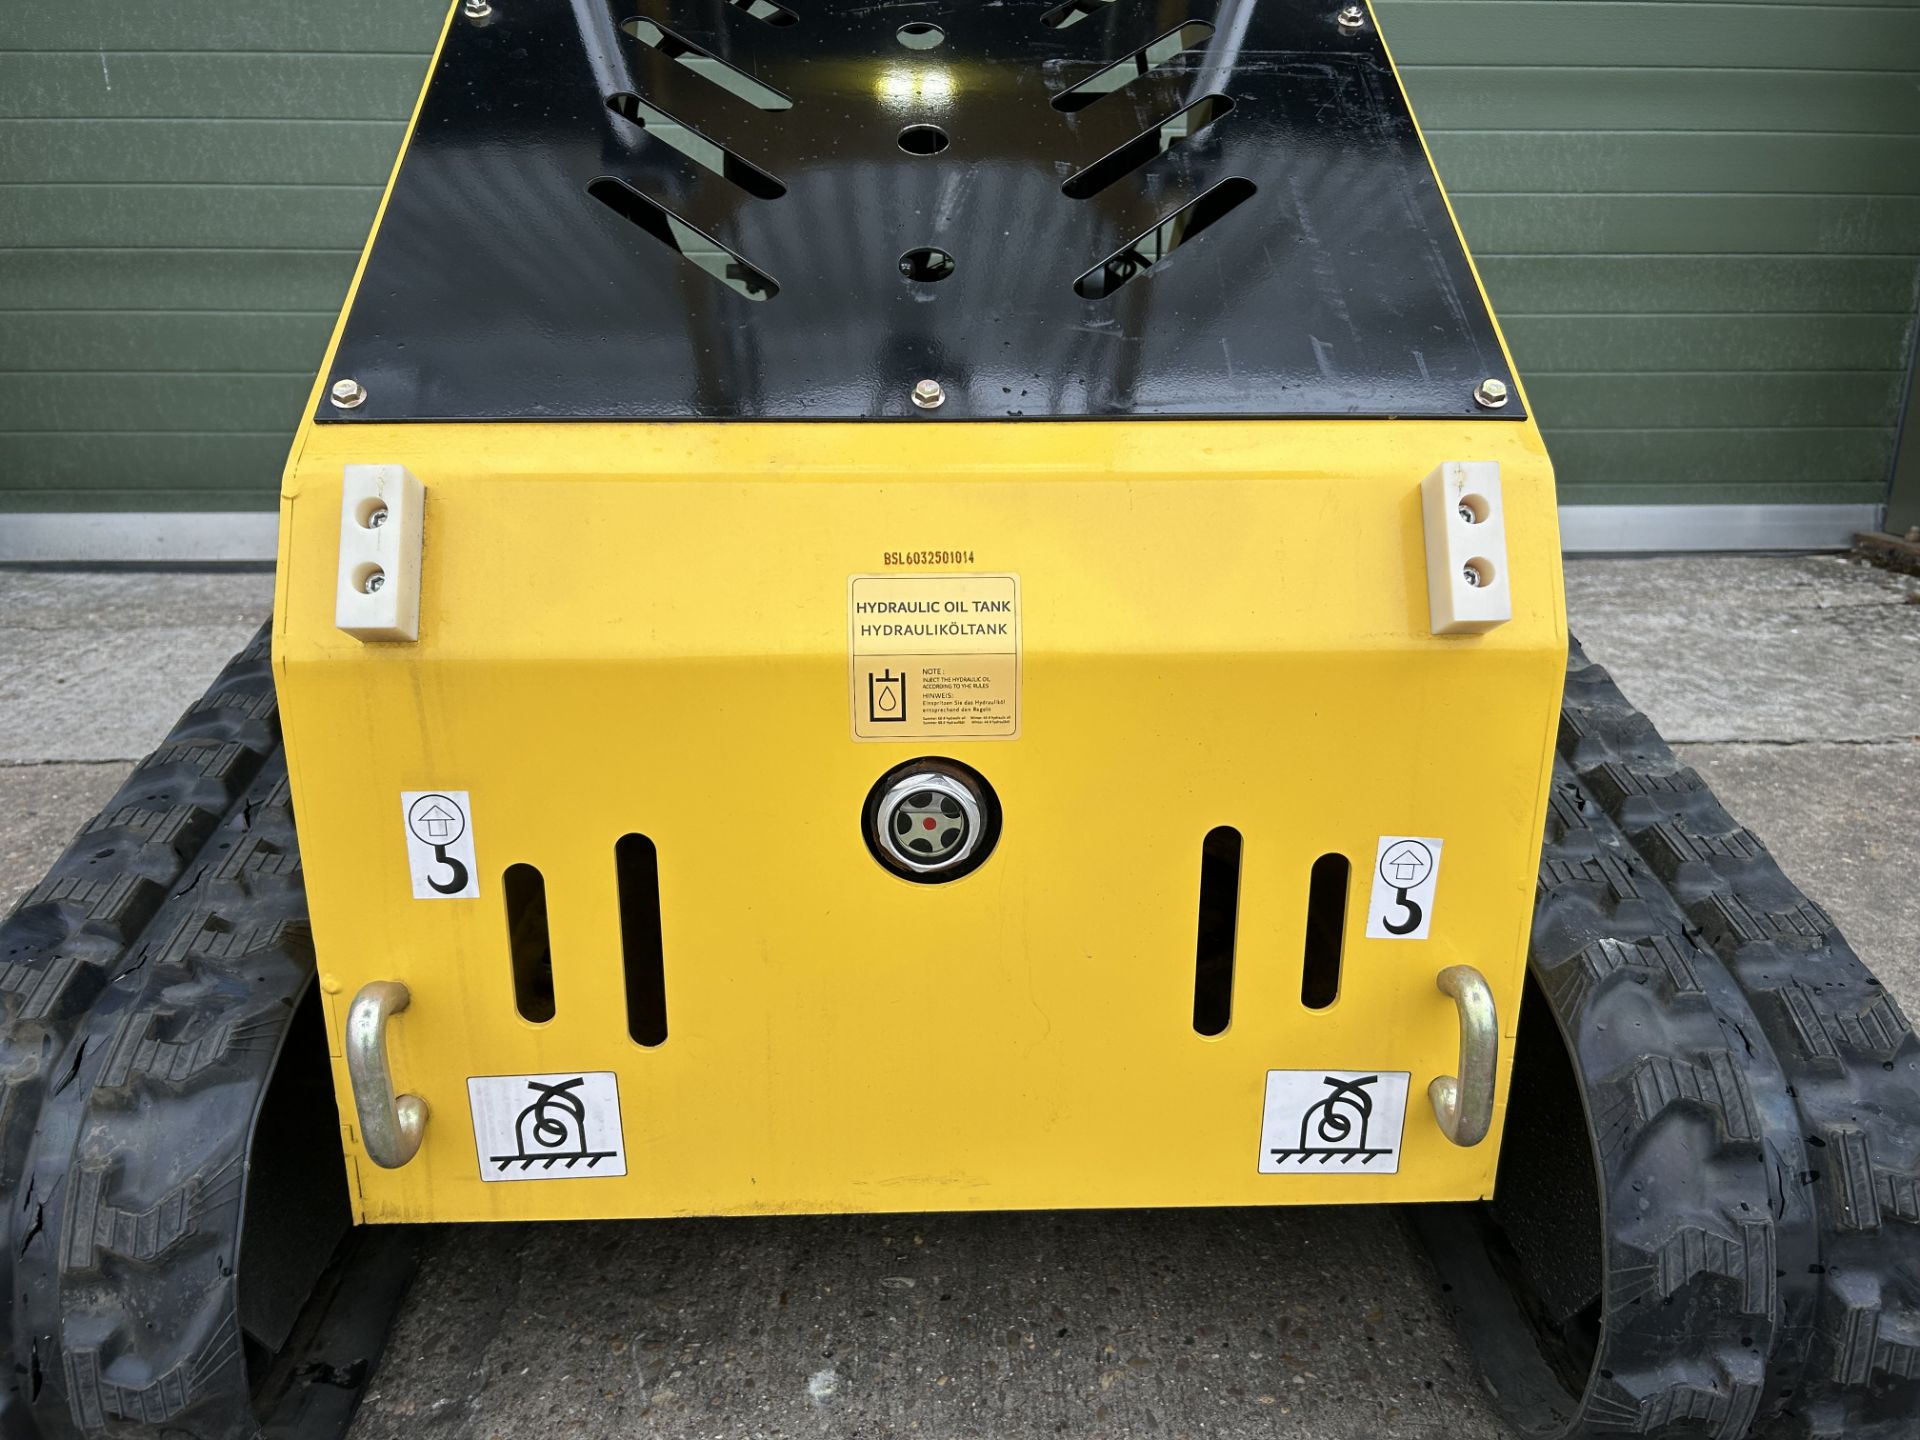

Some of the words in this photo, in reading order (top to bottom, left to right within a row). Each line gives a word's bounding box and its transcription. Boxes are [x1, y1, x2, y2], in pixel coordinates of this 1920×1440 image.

[884, 551, 974, 565] BSL6032501014
[856, 602, 940, 614] HYDRAULIC
[944, 601, 968, 613] OIL
[972, 600, 1011, 612] TANK
[861, 621, 1008, 636] HYDRAULIKÖLTANK
